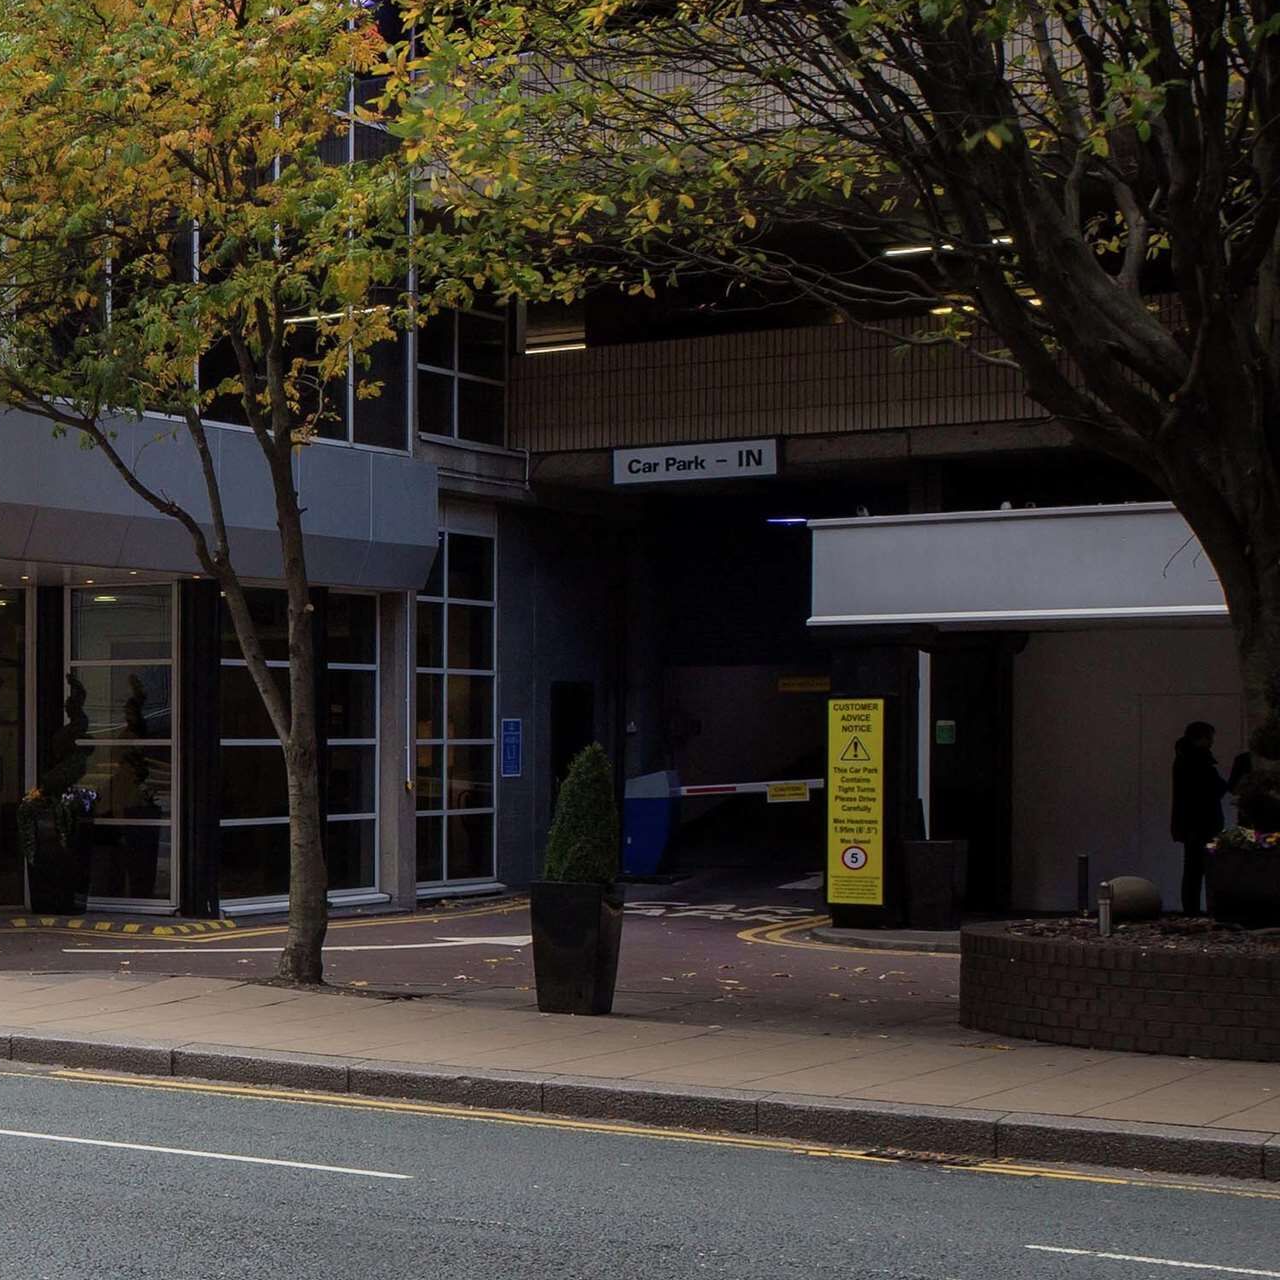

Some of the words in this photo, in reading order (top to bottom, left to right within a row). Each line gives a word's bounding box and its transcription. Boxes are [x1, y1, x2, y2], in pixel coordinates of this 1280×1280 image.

[628, 459, 660, 474] Car
[665, 456, 706, 472] Park
[738, 449, 762, 467] IN
[832, 703, 879, 711] CUSTOMER
[851, 853, 858, 863] 5
